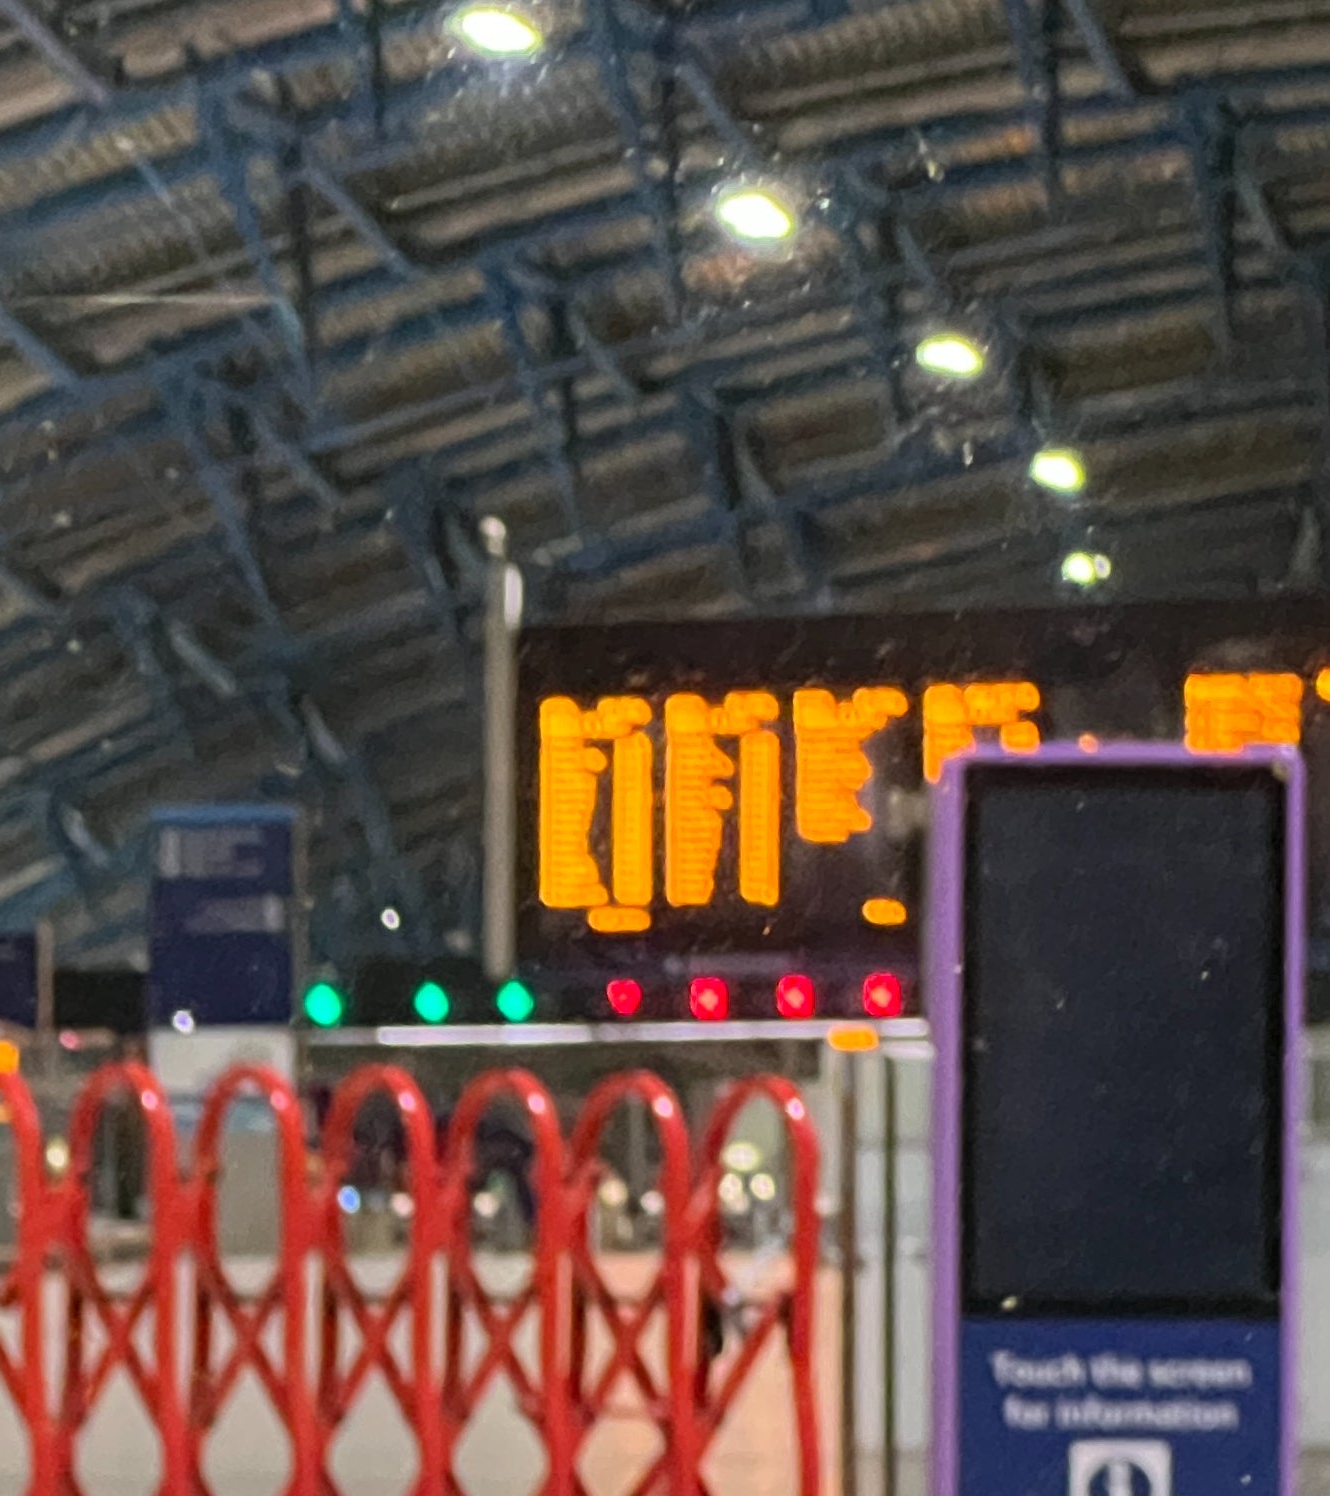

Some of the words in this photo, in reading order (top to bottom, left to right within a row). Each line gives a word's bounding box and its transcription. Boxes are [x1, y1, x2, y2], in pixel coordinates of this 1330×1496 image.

[992, 1350, 1085, 1388] Touch
[1091, 1354, 1142, 1388] the
[1147, 1359, 1252, 1388] screen
[1003, 1395, 1049, 1428] for
[1054, 1395, 1239, 1429] information
